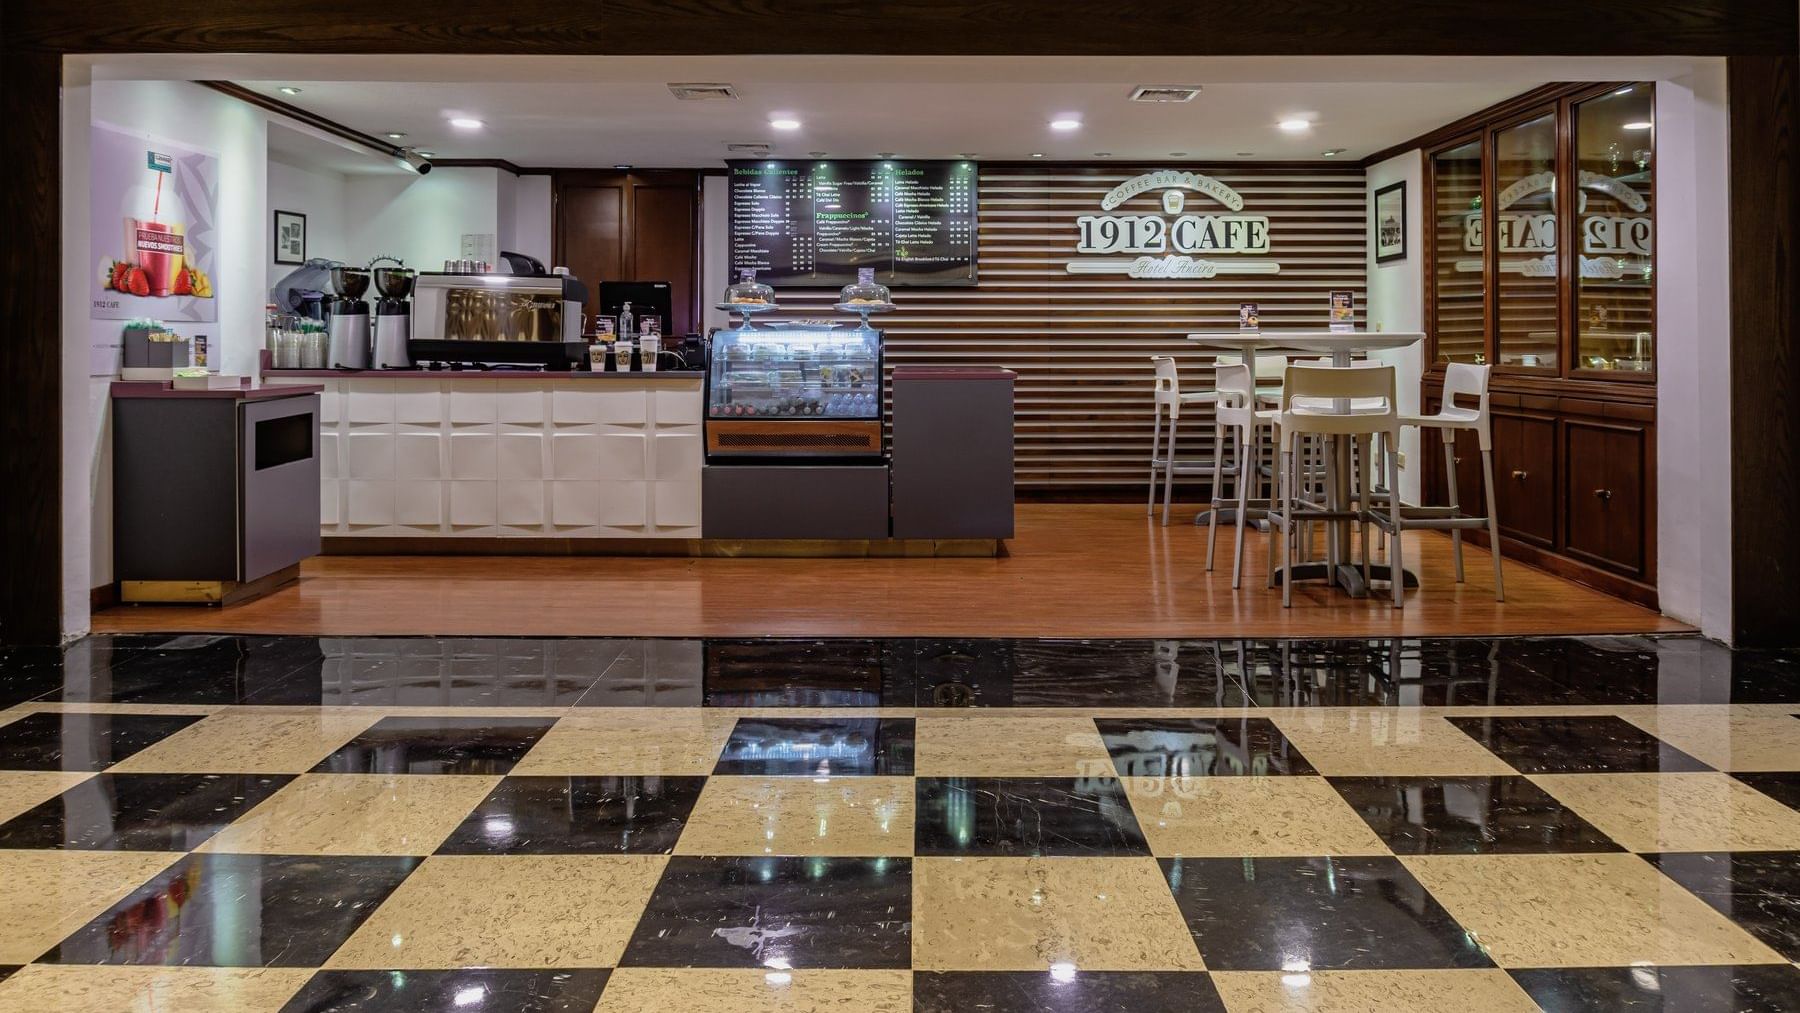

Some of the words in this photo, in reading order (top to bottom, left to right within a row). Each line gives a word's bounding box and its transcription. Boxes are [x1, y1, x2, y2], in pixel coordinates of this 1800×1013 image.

[1109, 179, 1150, 204] COFFEE
[1156, 176, 1177, 184] BAR
[1184, 176, 1191, 185] &
[1197, 179, 1238, 205] BAKERY
[1081, 220, 1162, 249] 1912
[1176, 220, 1266, 249] CAFE
[1133, 257, 1170, 274] Hotel
[1175, 257, 1214, 274] Ancira
